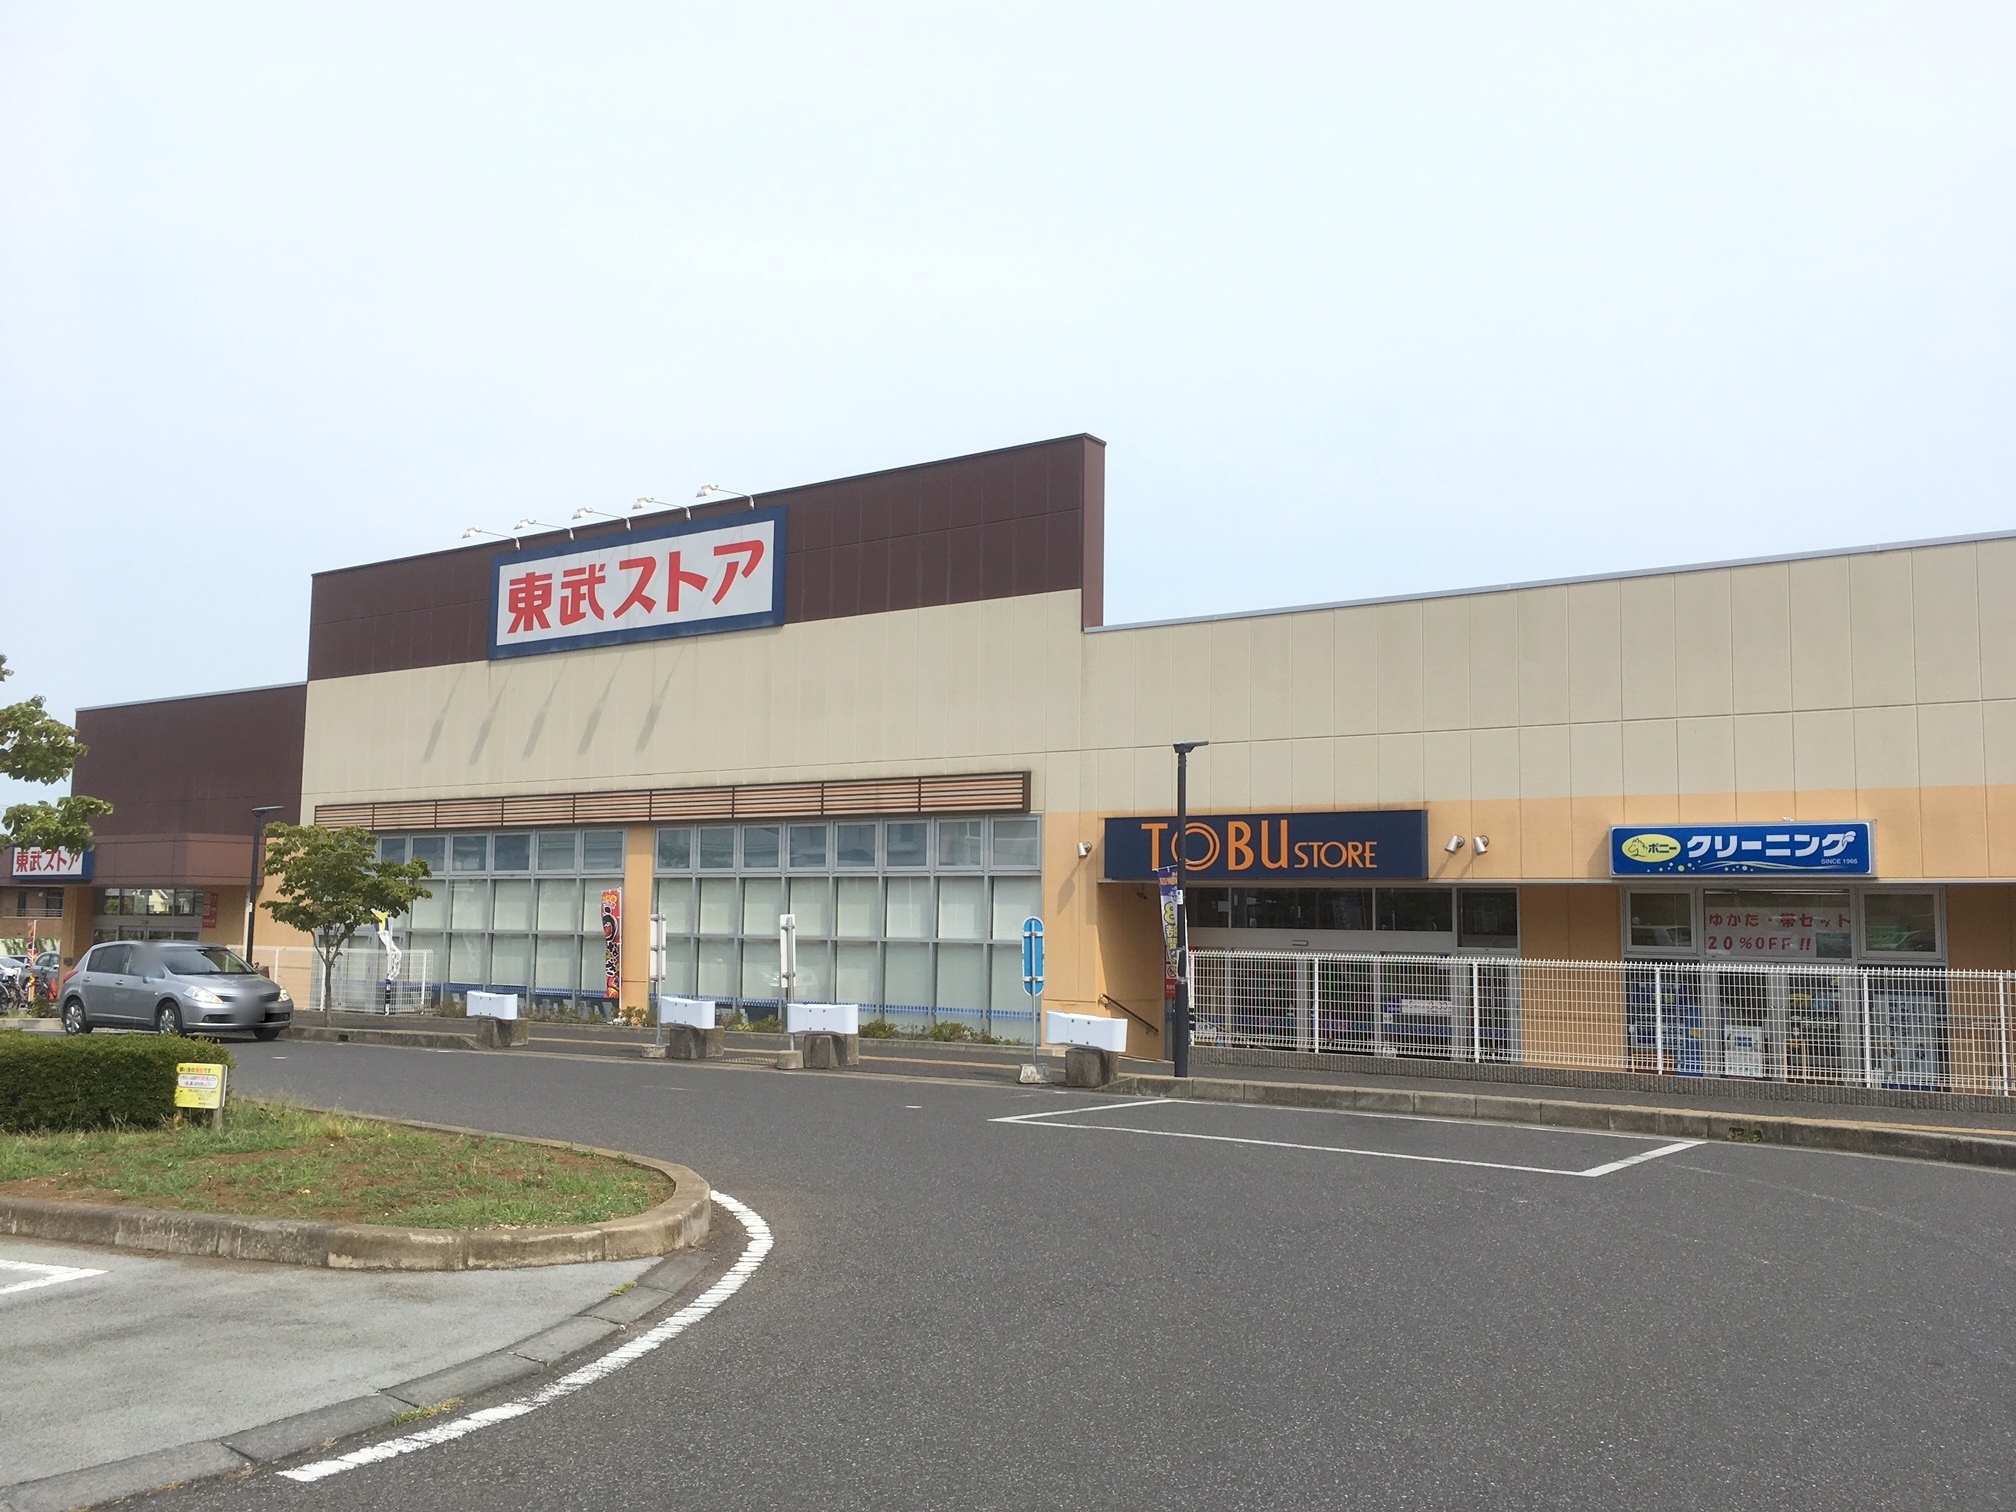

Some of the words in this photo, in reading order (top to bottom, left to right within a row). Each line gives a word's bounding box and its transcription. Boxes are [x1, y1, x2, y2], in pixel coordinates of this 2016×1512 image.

[507, 539, 765, 634] 東武ストア
[1141, 819, 1288, 871] TOBU
[1294, 841, 1378, 868] STORE
[1647, 843, 1678, 855] ポニー
[1687, 830, 1857, 858] クリーニング
